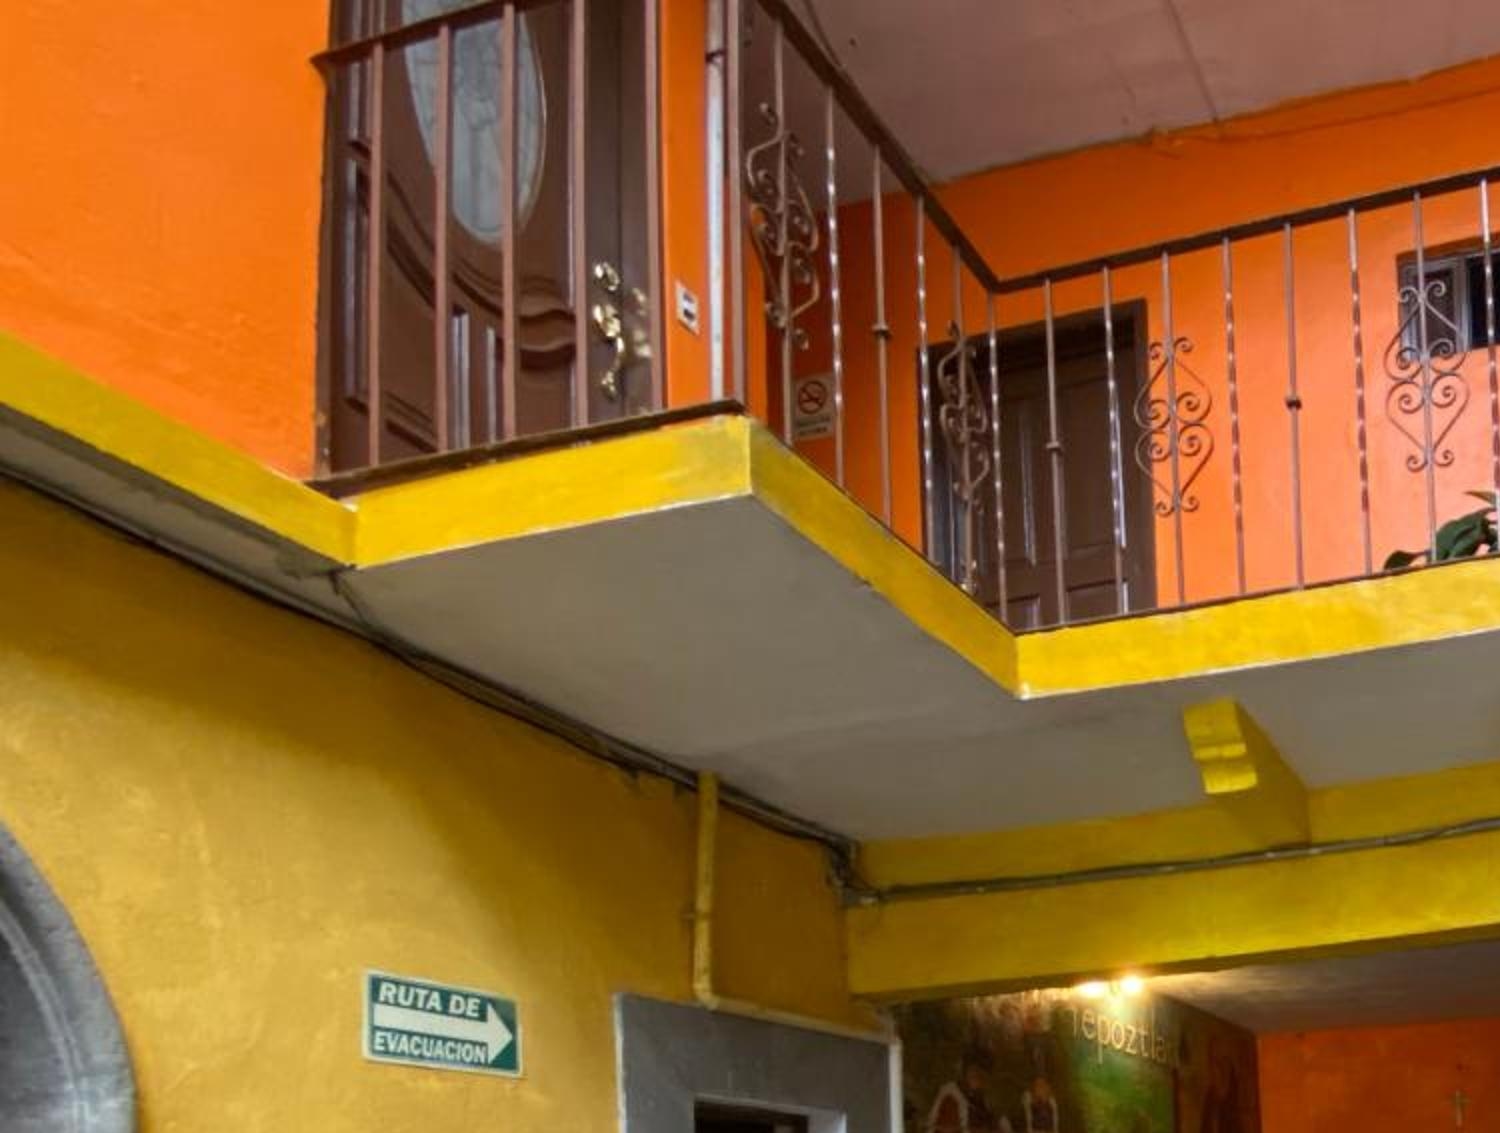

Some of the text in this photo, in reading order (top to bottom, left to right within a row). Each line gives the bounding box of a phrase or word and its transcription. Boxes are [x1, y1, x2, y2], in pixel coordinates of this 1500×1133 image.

[379, 982, 480, 1017] RUTA DE
[374, 1031, 487, 1063] EVACUACION
